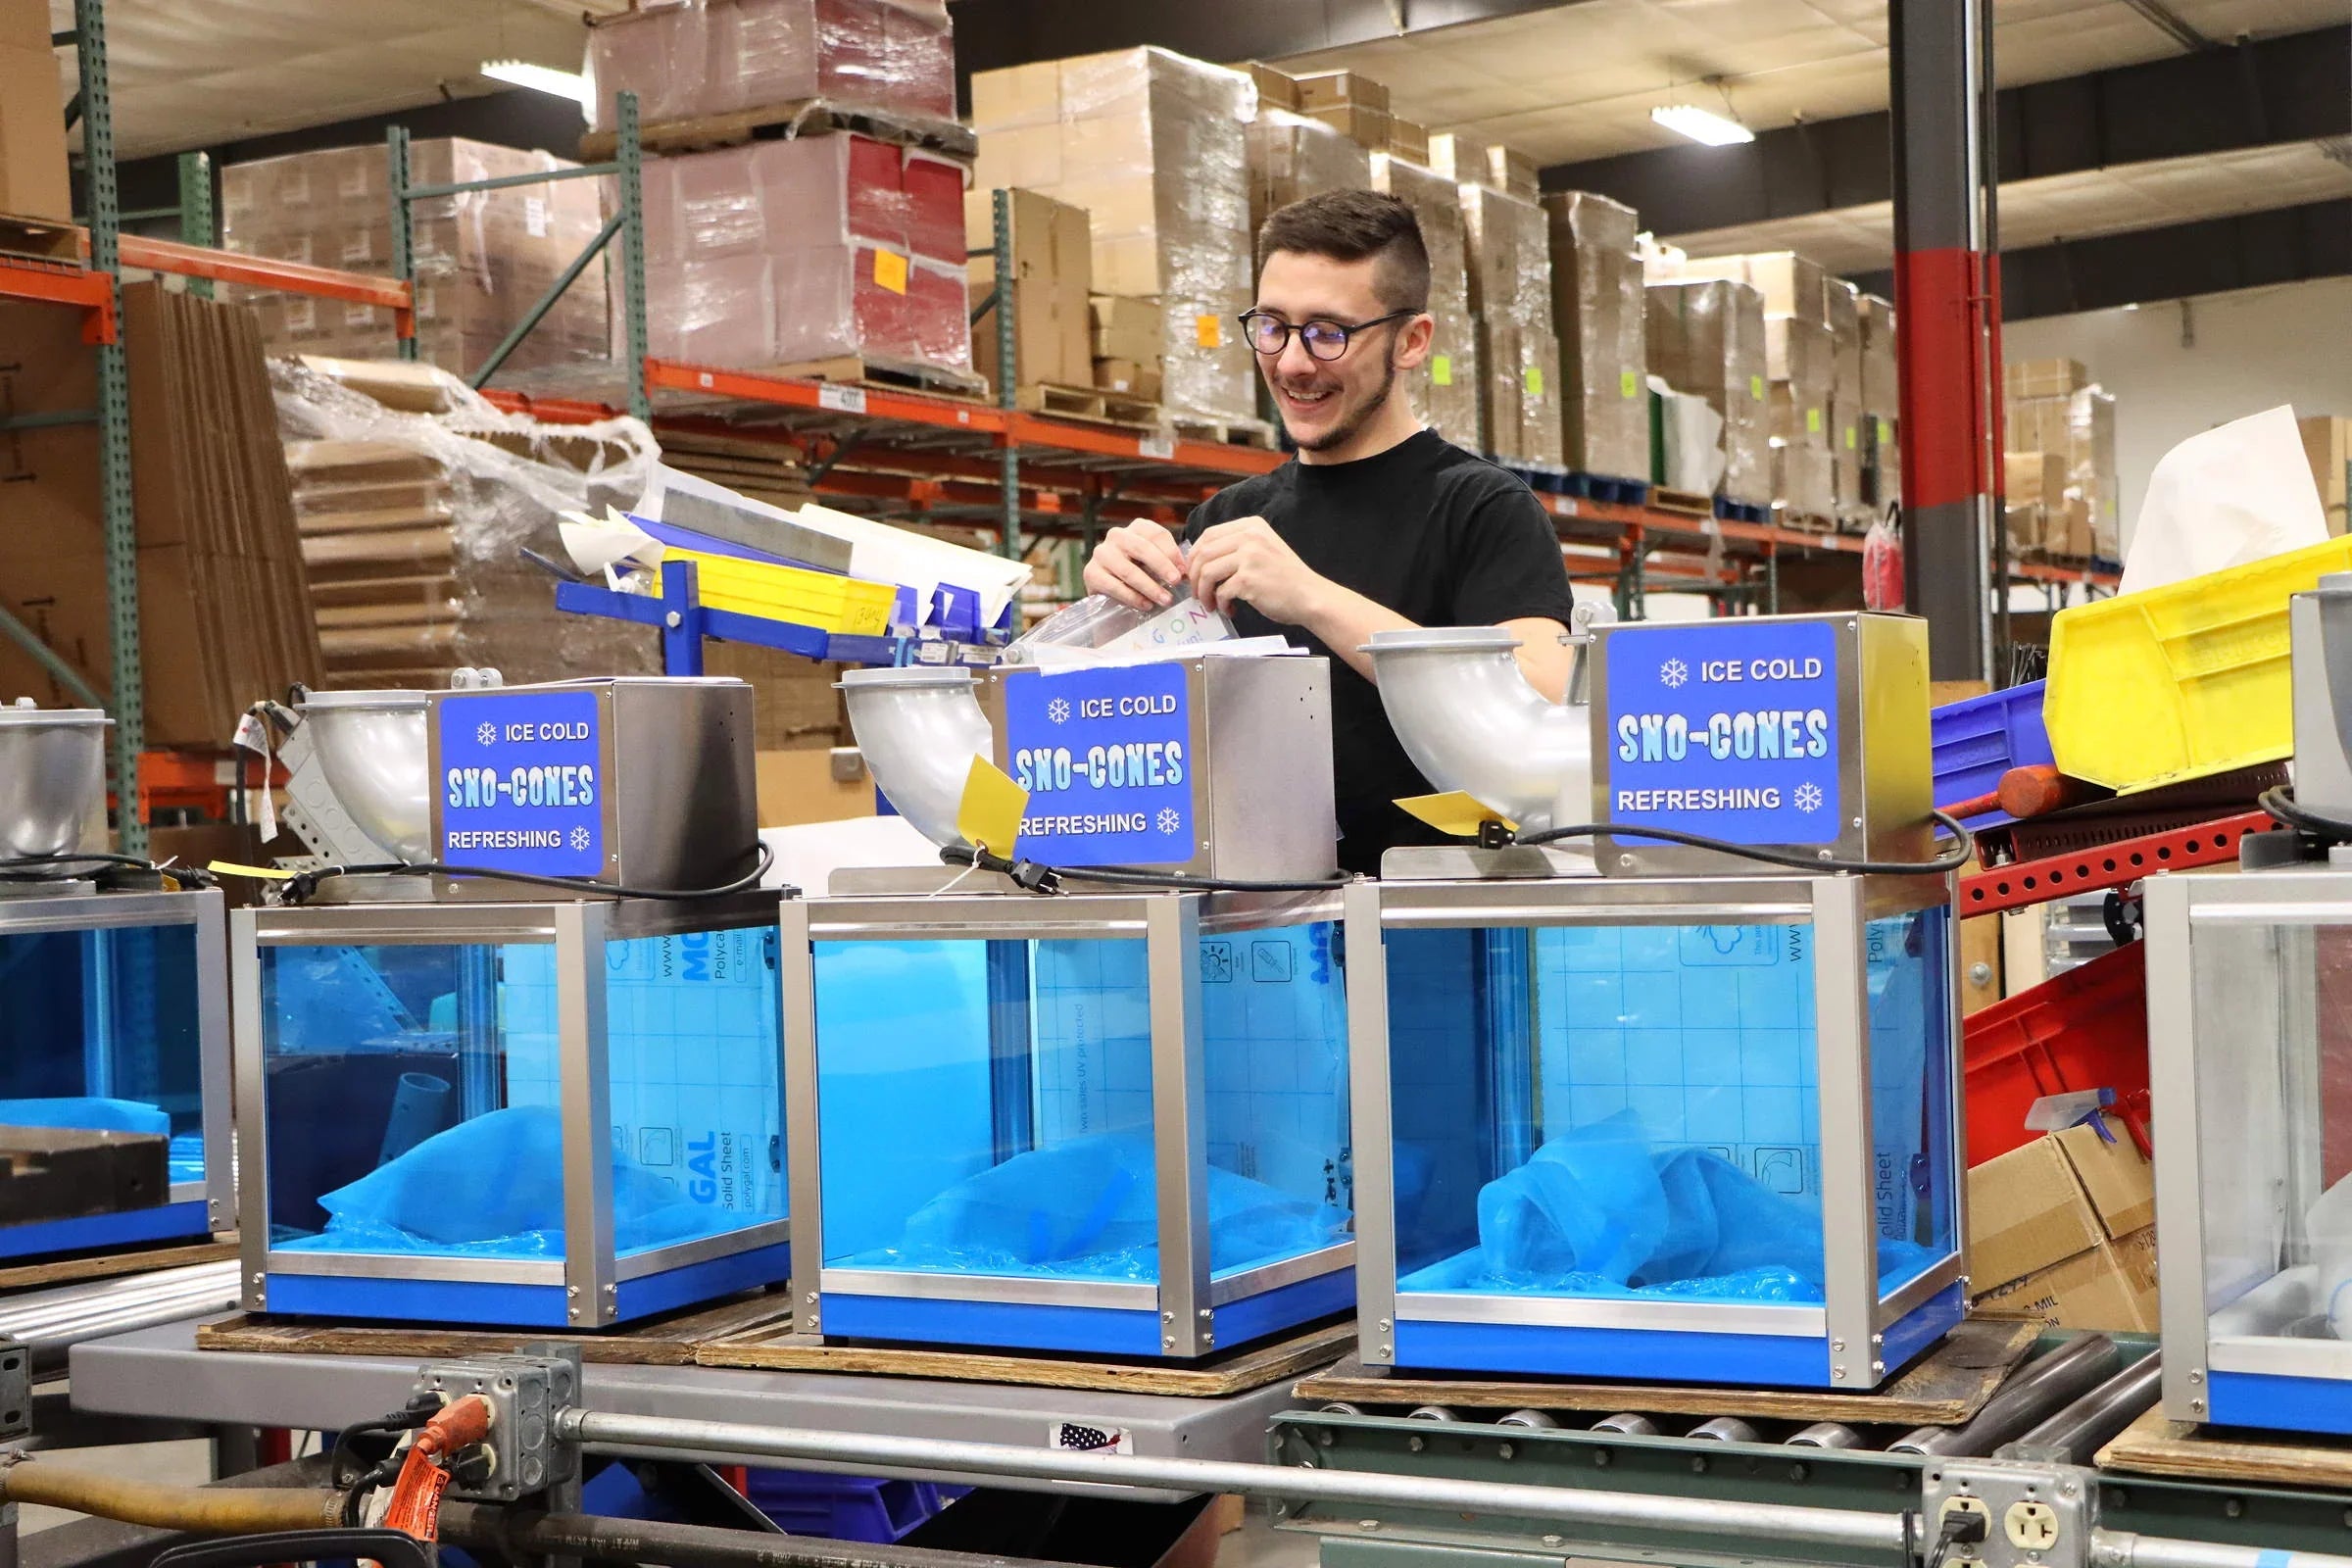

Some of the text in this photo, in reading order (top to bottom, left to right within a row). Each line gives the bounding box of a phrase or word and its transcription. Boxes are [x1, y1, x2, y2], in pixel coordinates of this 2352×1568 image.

[1701, 658, 1823, 682] ICE COLD
[1081, 695, 1177, 718] ICE COLD
[506, 722, 590, 742] ICE COLD
[1616, 709, 1828, 762] SNO-CONES
[448, 764, 594, 808] SNO-CONES
[1015, 741, 1184, 792] SNO-CONES
[1618, 788, 1781, 811] REFRESHING
[449, 830, 562, 849] REFRESHING
[1019, 812, 1147, 836] REFRESHING
[1866, 922, 1885, 962] Poly
[688, 1131, 717, 1204] GAL
[720, 1131, 733, 1172] Sheet
[1876, 1152, 1892, 1200] Sheet
